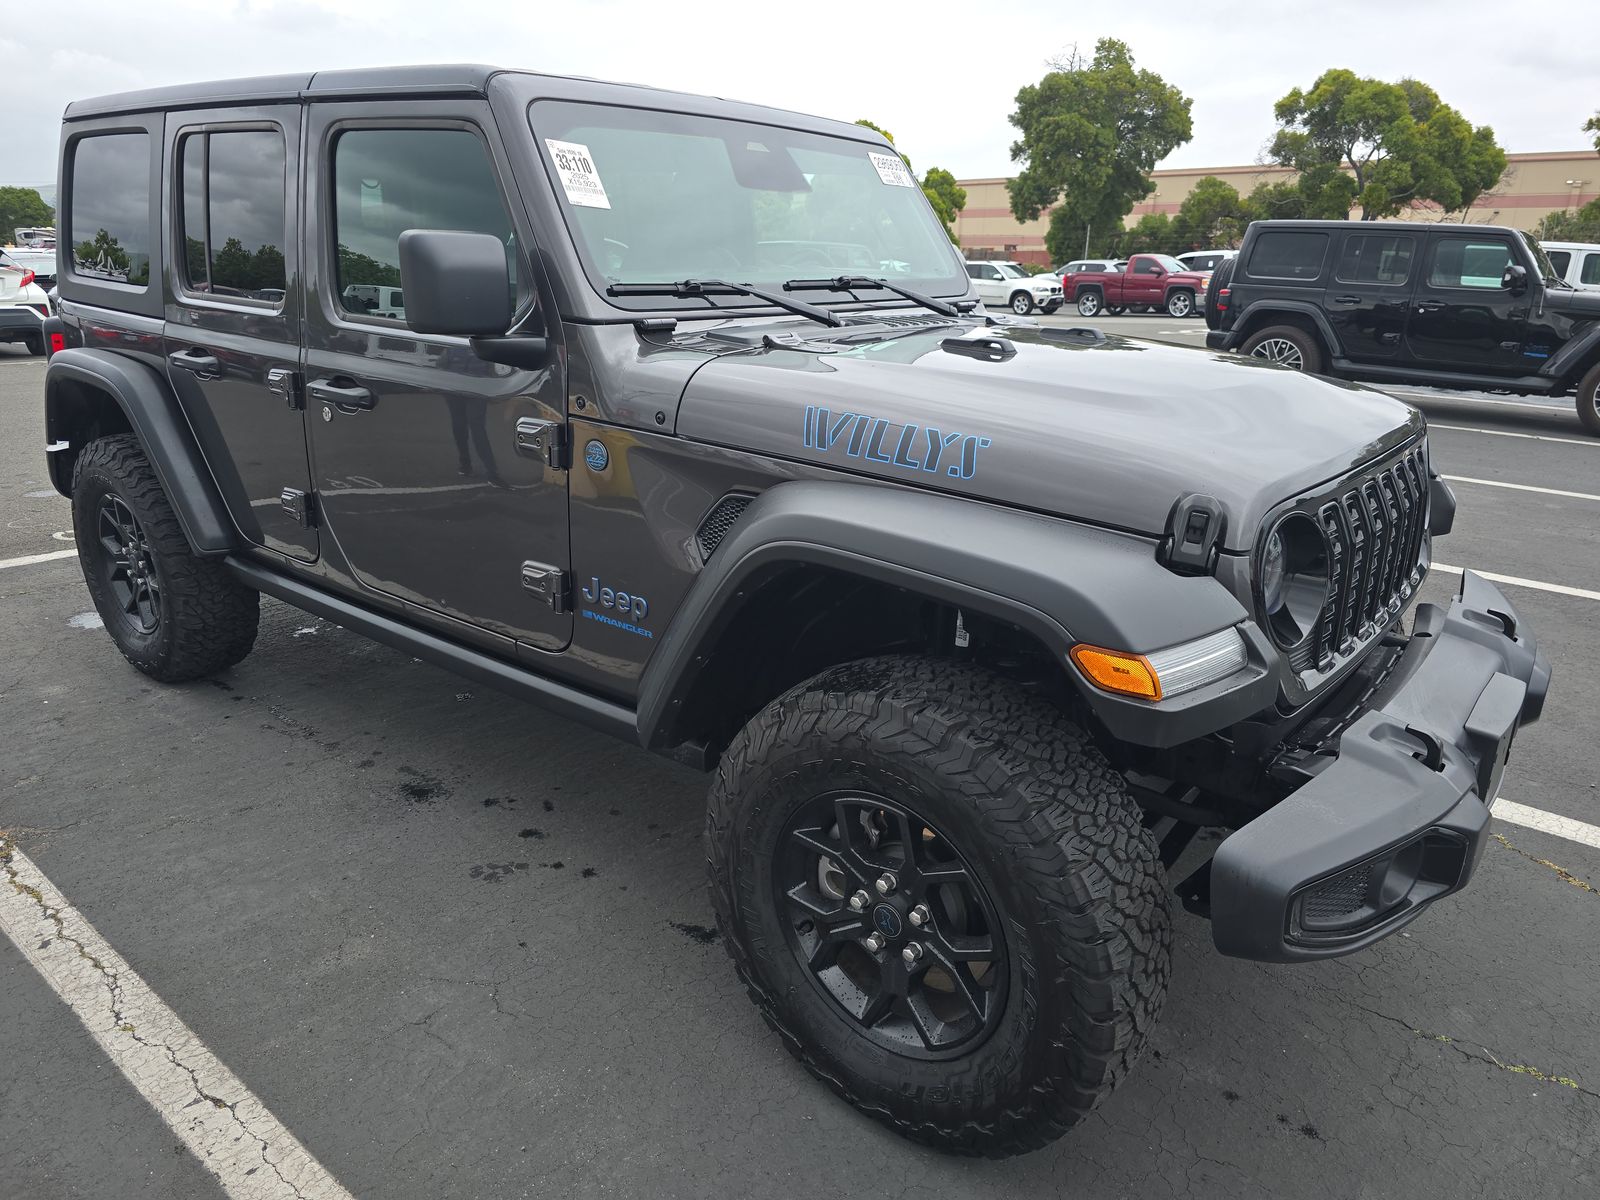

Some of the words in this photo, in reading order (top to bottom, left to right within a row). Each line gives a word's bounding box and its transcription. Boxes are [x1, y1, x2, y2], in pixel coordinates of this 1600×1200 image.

[556, 153, 592, 174] 33:110
[571, 172, 589, 180] 2025
[803, 404, 992, 480] WILLYS
[581, 576, 649, 623] Jeep
[591, 611, 654, 639] WRANGLER
